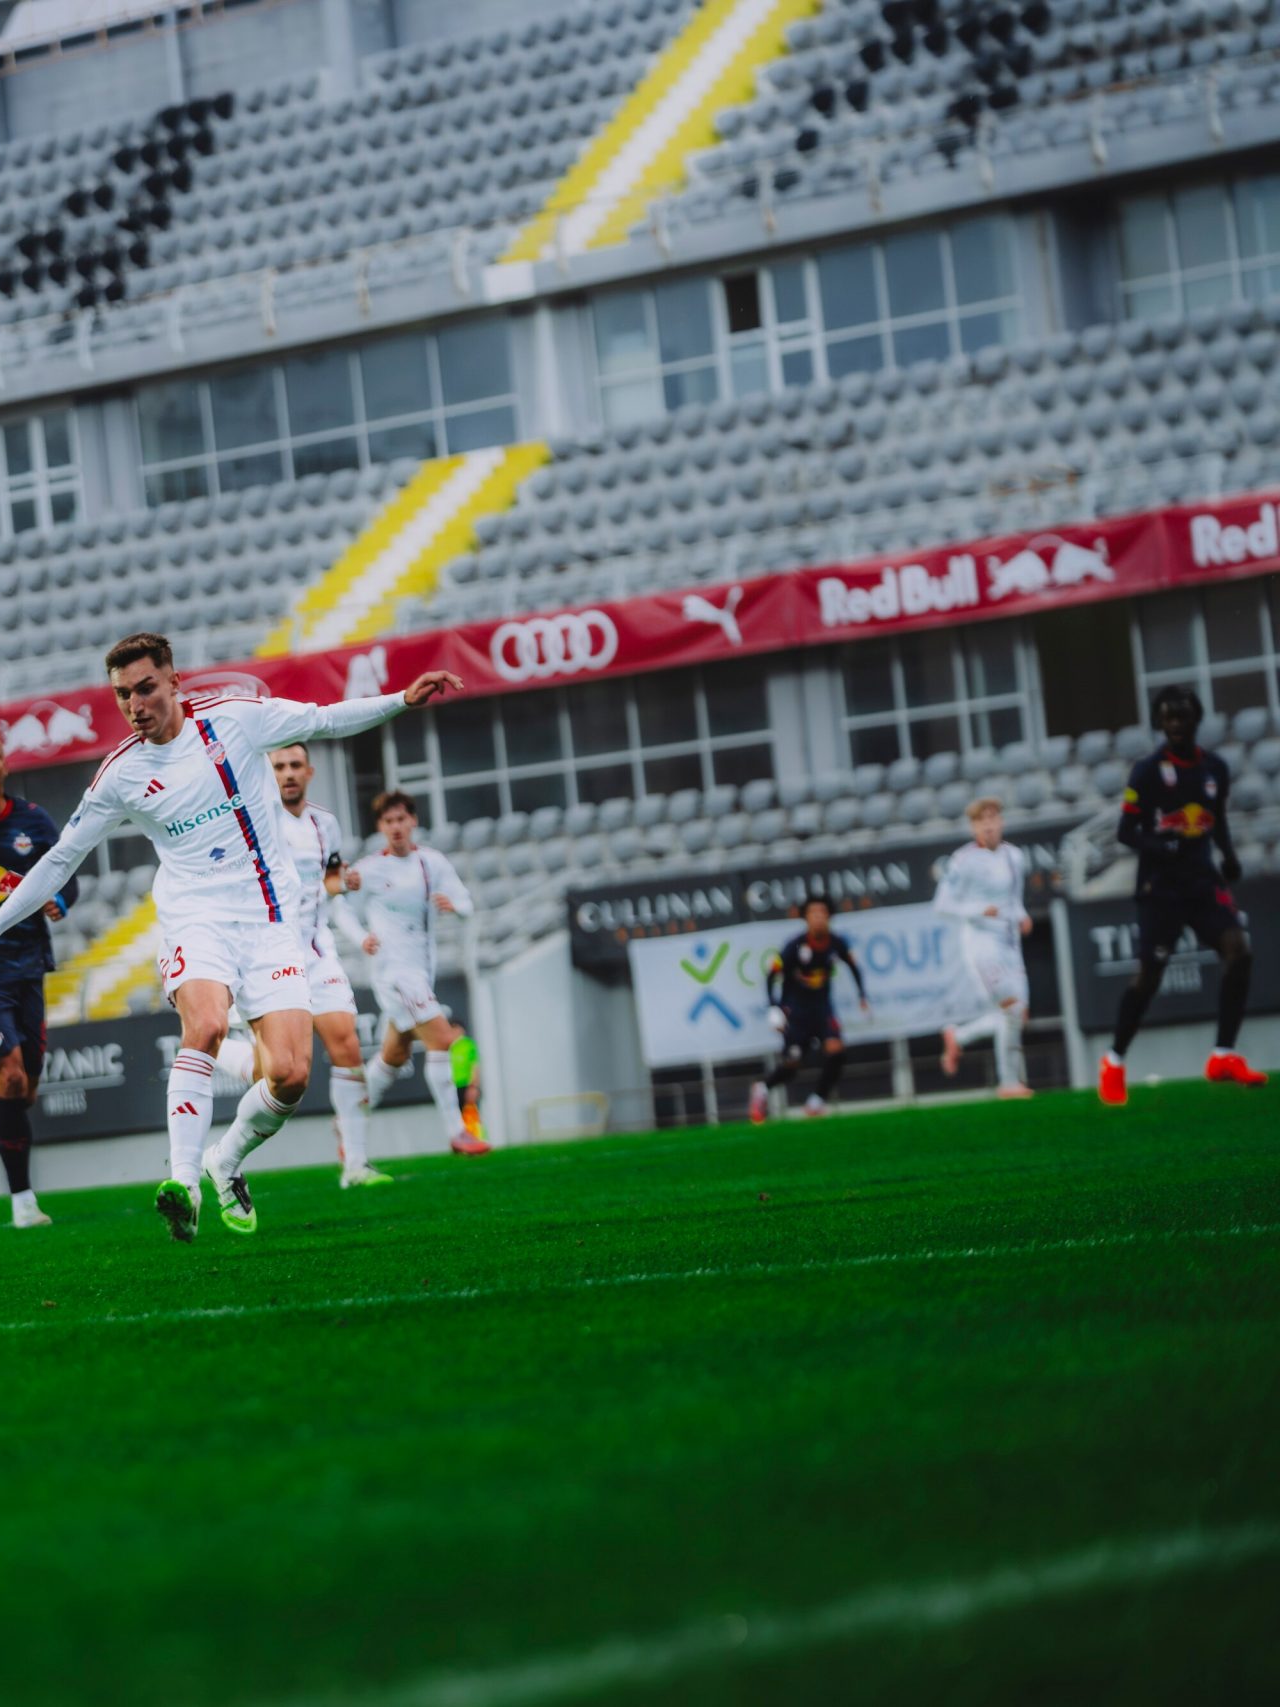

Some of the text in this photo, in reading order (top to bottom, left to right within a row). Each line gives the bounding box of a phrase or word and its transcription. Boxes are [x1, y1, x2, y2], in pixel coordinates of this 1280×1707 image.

[1190, 502, 1277, 569] Red
[165, 793, 245, 838] Hisense
[577, 885, 733, 933] CULLINAN
